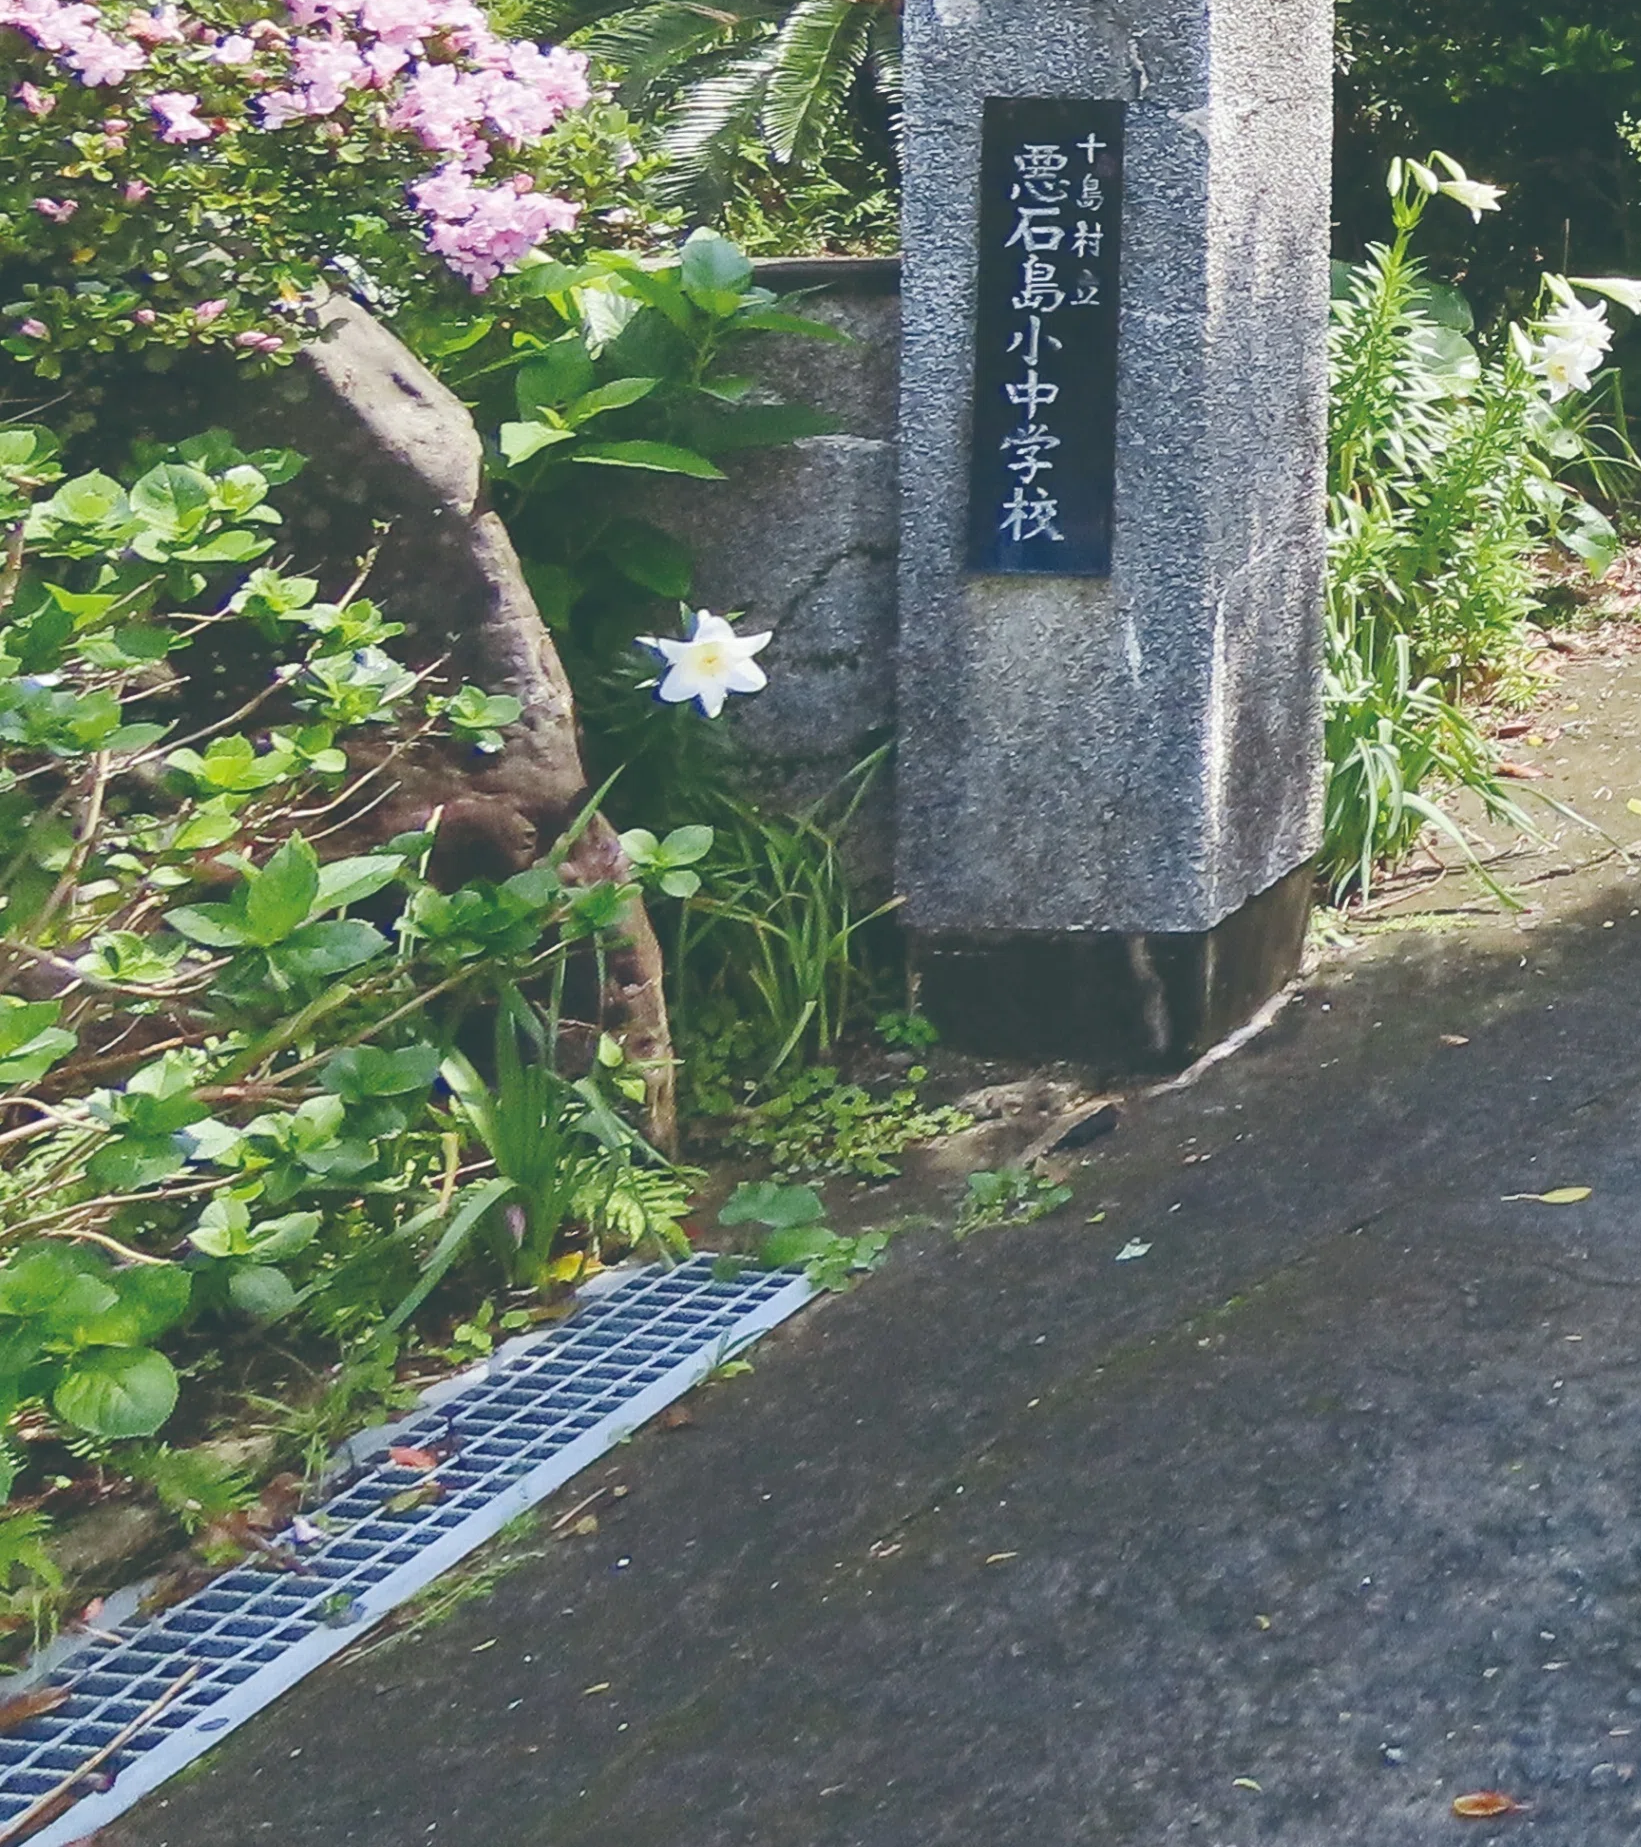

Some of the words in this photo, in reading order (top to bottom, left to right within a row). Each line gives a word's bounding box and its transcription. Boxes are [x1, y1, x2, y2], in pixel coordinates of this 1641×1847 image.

[999, 143, 1070, 542] 悪石島小中学校
[1069, 132, 1107, 306] 十島村立
